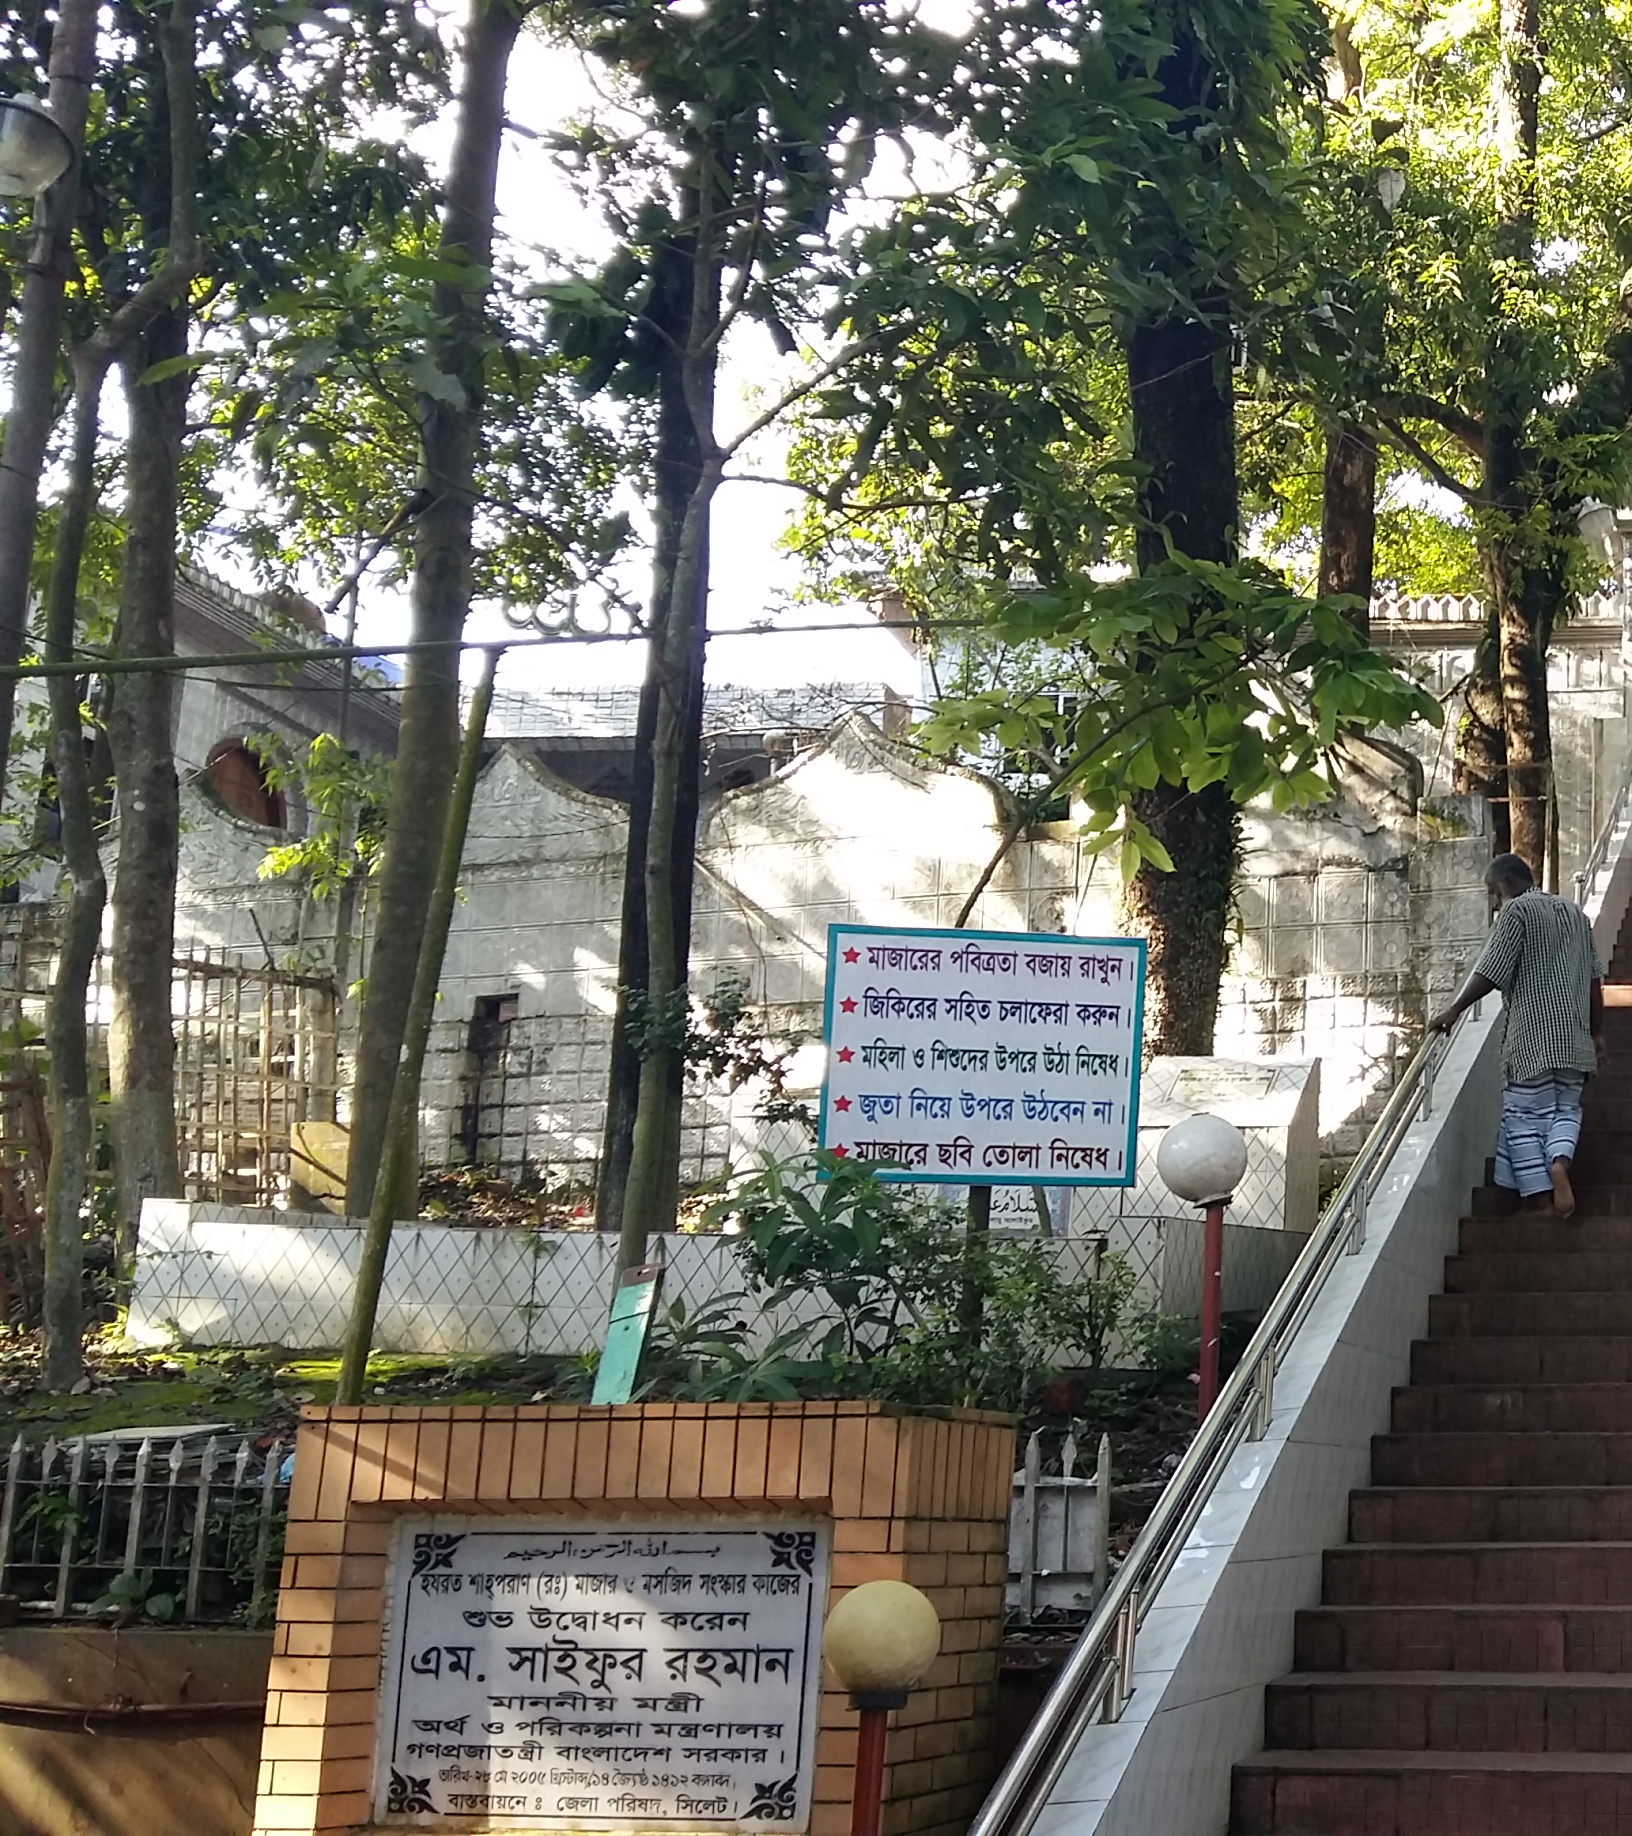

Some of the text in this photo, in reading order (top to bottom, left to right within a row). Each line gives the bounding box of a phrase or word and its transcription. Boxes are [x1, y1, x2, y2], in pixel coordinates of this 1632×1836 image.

[867, 944, 941, 972] মাজারের
[950, 943, 1018, 976] পবিত্রতা
[1026, 952, 1072, 979] বজায়
[862, 988, 937, 1020] জিকিরের
[945, 991, 992, 1025] সহিত
[998, 998, 1069, 1027] চলাফেরা
[861, 1038, 905, 1071] মহিলা
[913, 1050, 924, 1069] ও
[931, 1040, 988, 1073] শিশুদের
[995, 1043, 1036, 1074] উপরে
[1044, 1041, 1070, 1075] উঠা
[858, 1092, 901, 1124] জুতা
[909, 1088, 952, 1119] নিয়ে
[959, 1089, 1013, 1121] উপরে
[1022, 1090, 1085, 1124] উঠবেন
[853, 1139, 928, 1169] মাজারে
[937, 1136, 973, 1168] ছবি
[983, 1142, 1042, 1169] তোলা
[421, 1573, 463, 1596] হযরত
[574, 1572, 618, 1596] মাজার
[642, 1566, 693, 1596] মসজিদ
[752, 1573, 802, 1596] কাজের
[463, 1605, 751, 1633] শুভ উদ্বোধন করেন
[411, 1634, 795, 1693] এম. সাইফুর রহমান
[487, 1691, 619, 1713] মাননীয়
[412, 1715, 472, 1736] অর্থ
[481, 1721, 505, 1737] ও
[554, 1745, 673, 1763] বাংলাদেশ
[556, 1796, 600, 1813] জেলা
